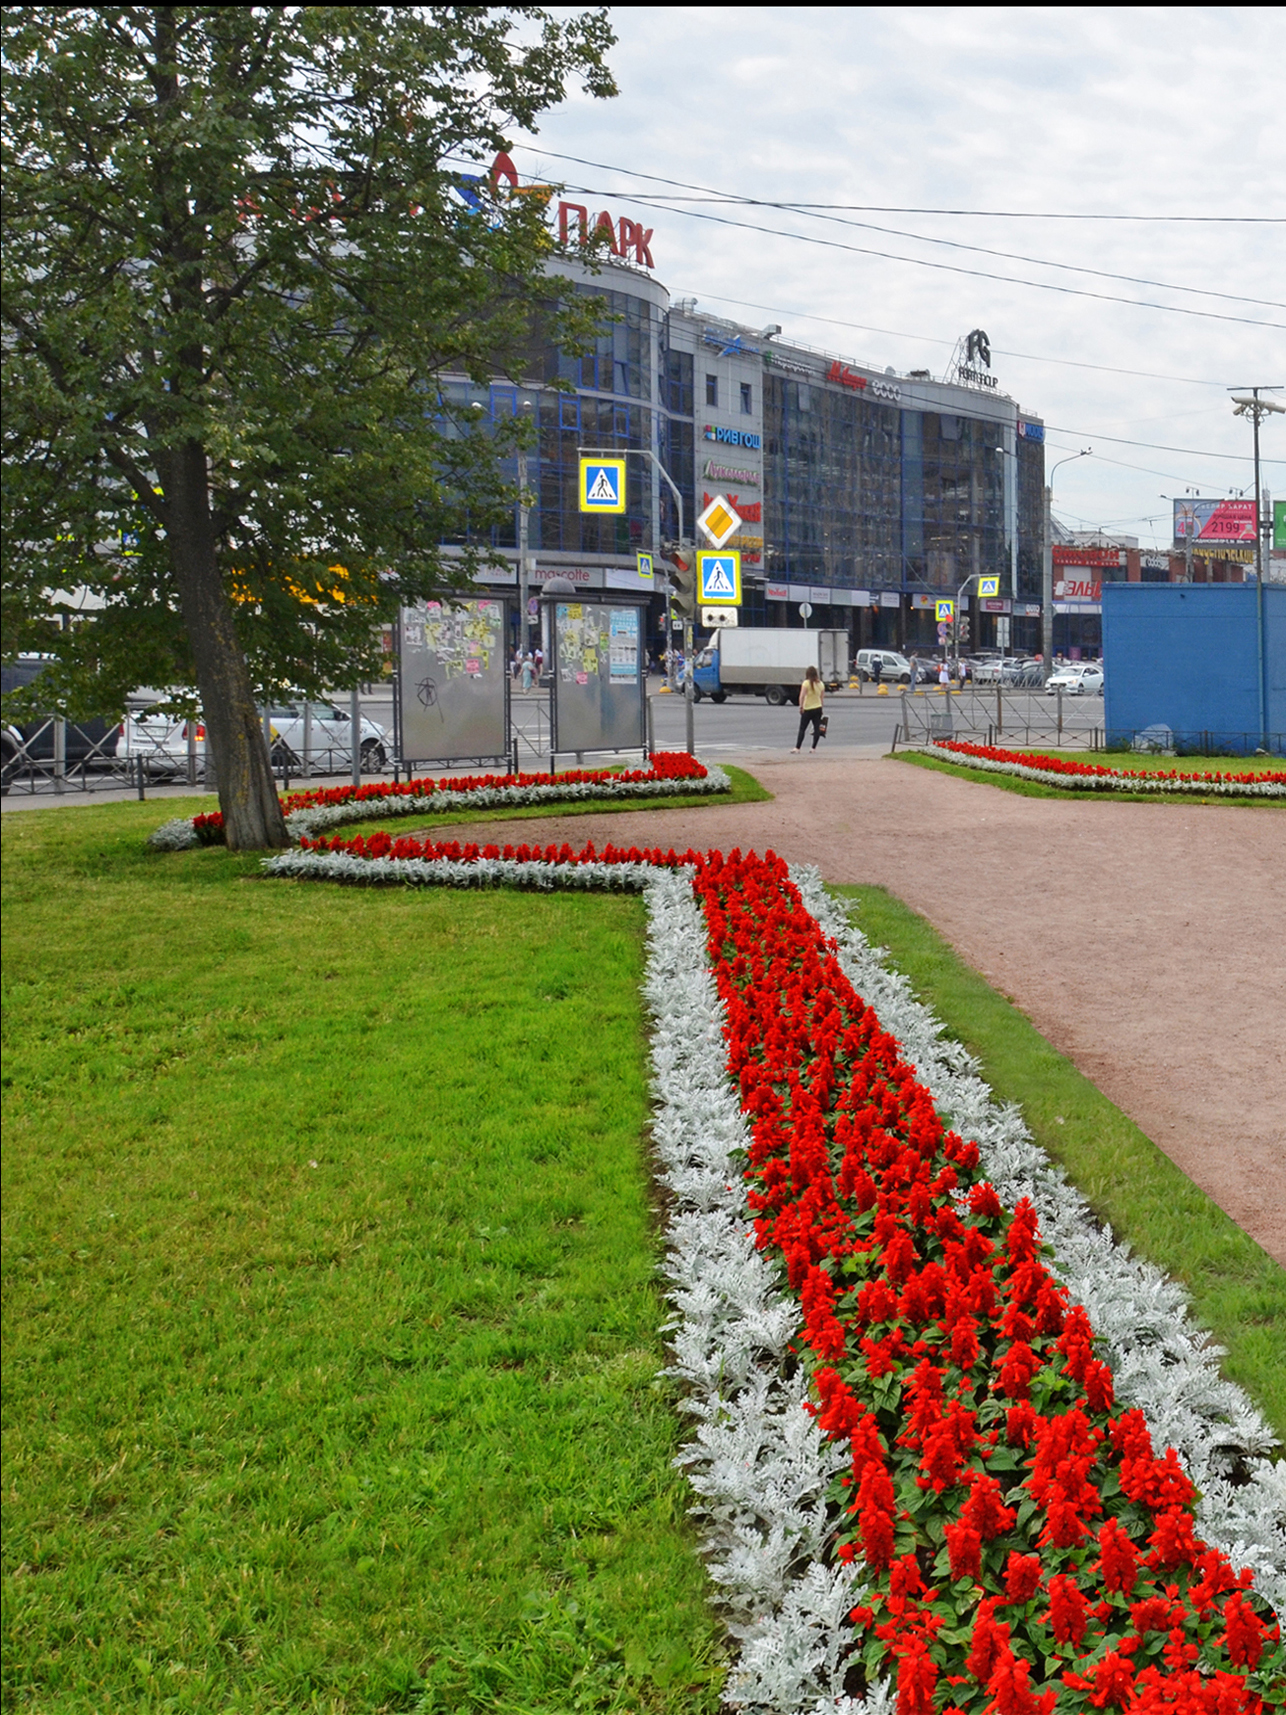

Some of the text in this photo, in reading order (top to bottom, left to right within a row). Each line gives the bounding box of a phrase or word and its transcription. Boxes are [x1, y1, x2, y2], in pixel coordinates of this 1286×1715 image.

[558, 201, 655, 269] ПАРК
[1211, 521, 1240, 533] 2199
[535, 568, 590, 582] mascotte
